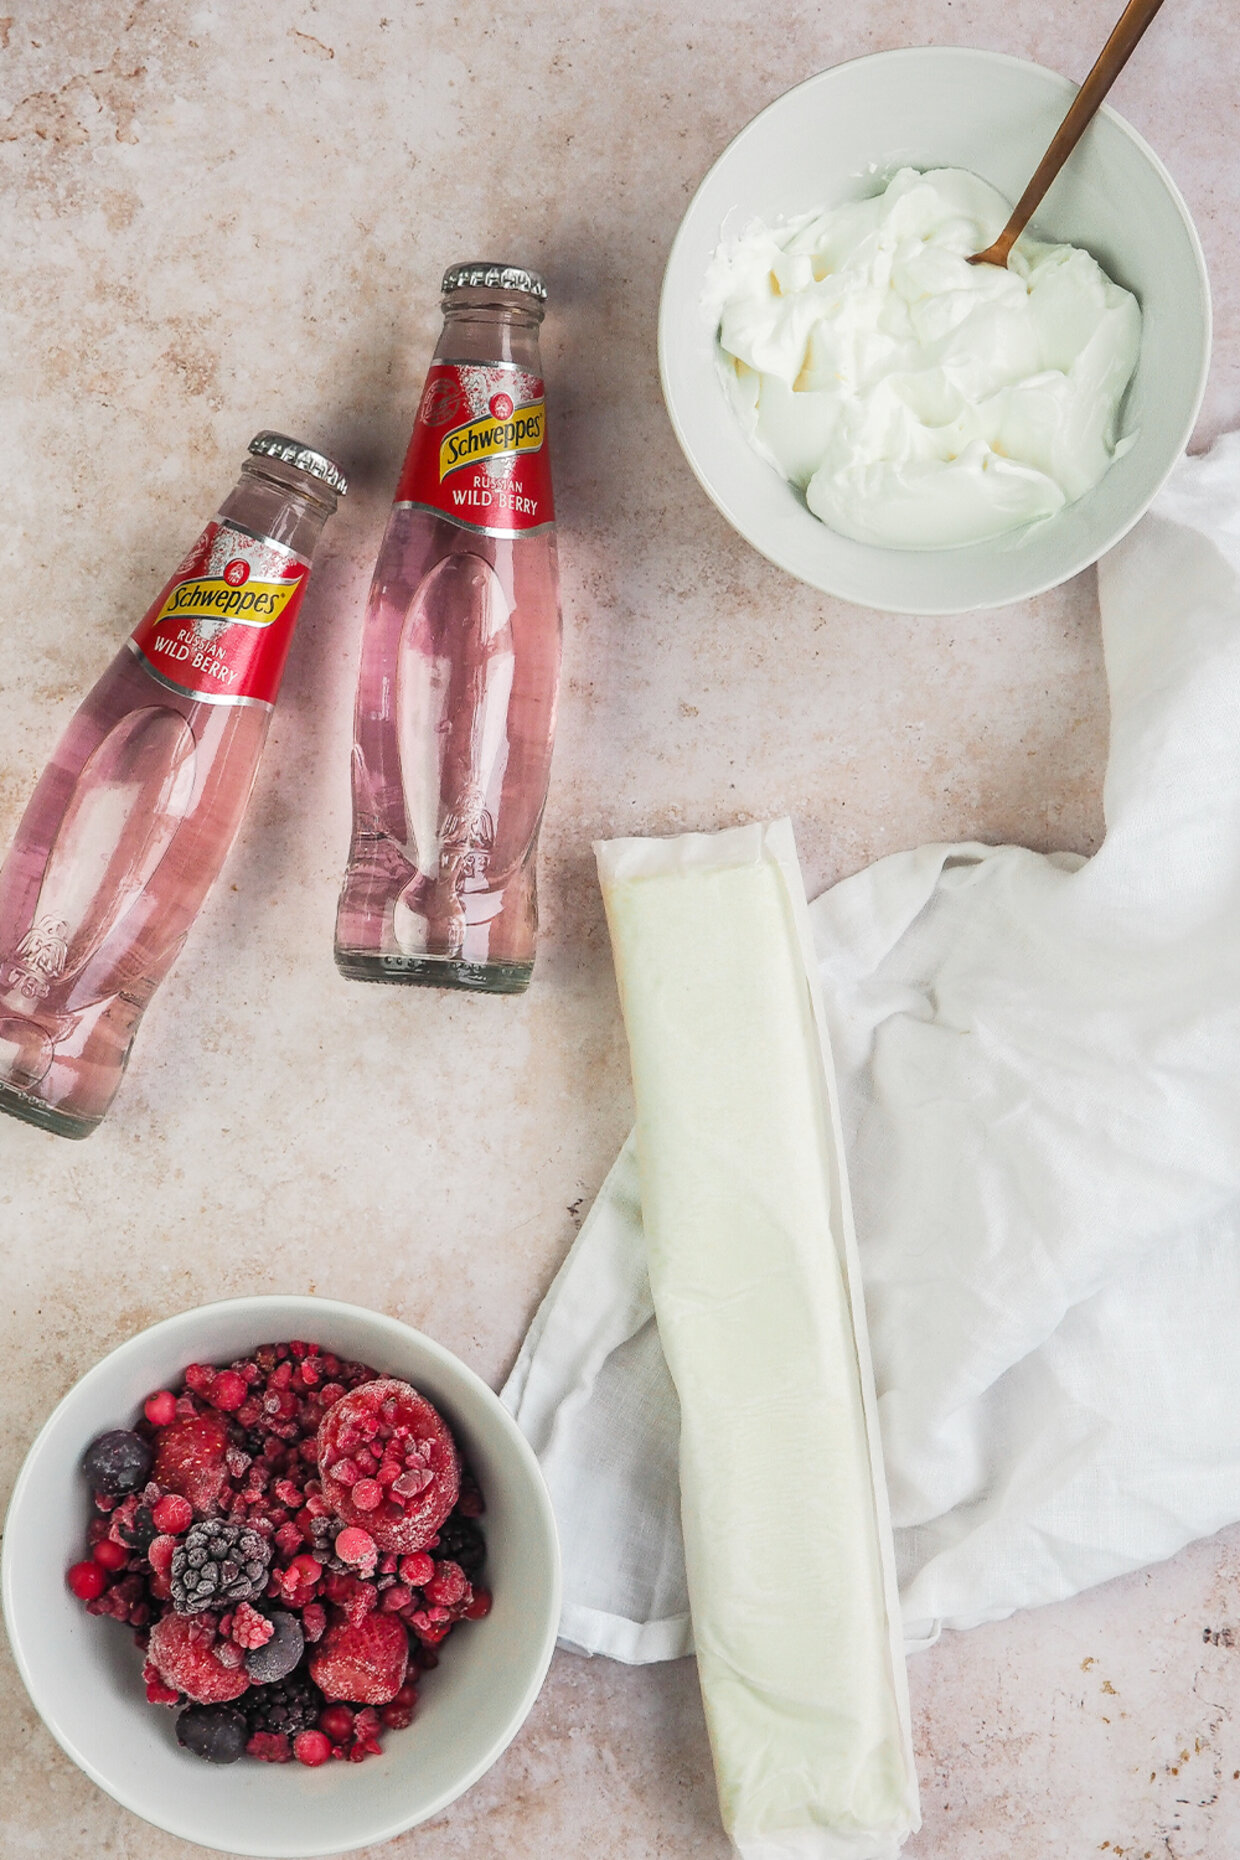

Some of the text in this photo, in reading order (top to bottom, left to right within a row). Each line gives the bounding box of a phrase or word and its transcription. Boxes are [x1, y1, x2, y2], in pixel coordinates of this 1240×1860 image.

[447, 415, 541, 465] Schweppes
[473, 475, 523, 493] RUSSIAN
[452, 490, 538, 516] WILD BERRY
[167, 586, 279, 615] Schweppes
[177, 629, 227, 660] RUSSIAN
[154, 635, 238, 685] WILD BERRY
